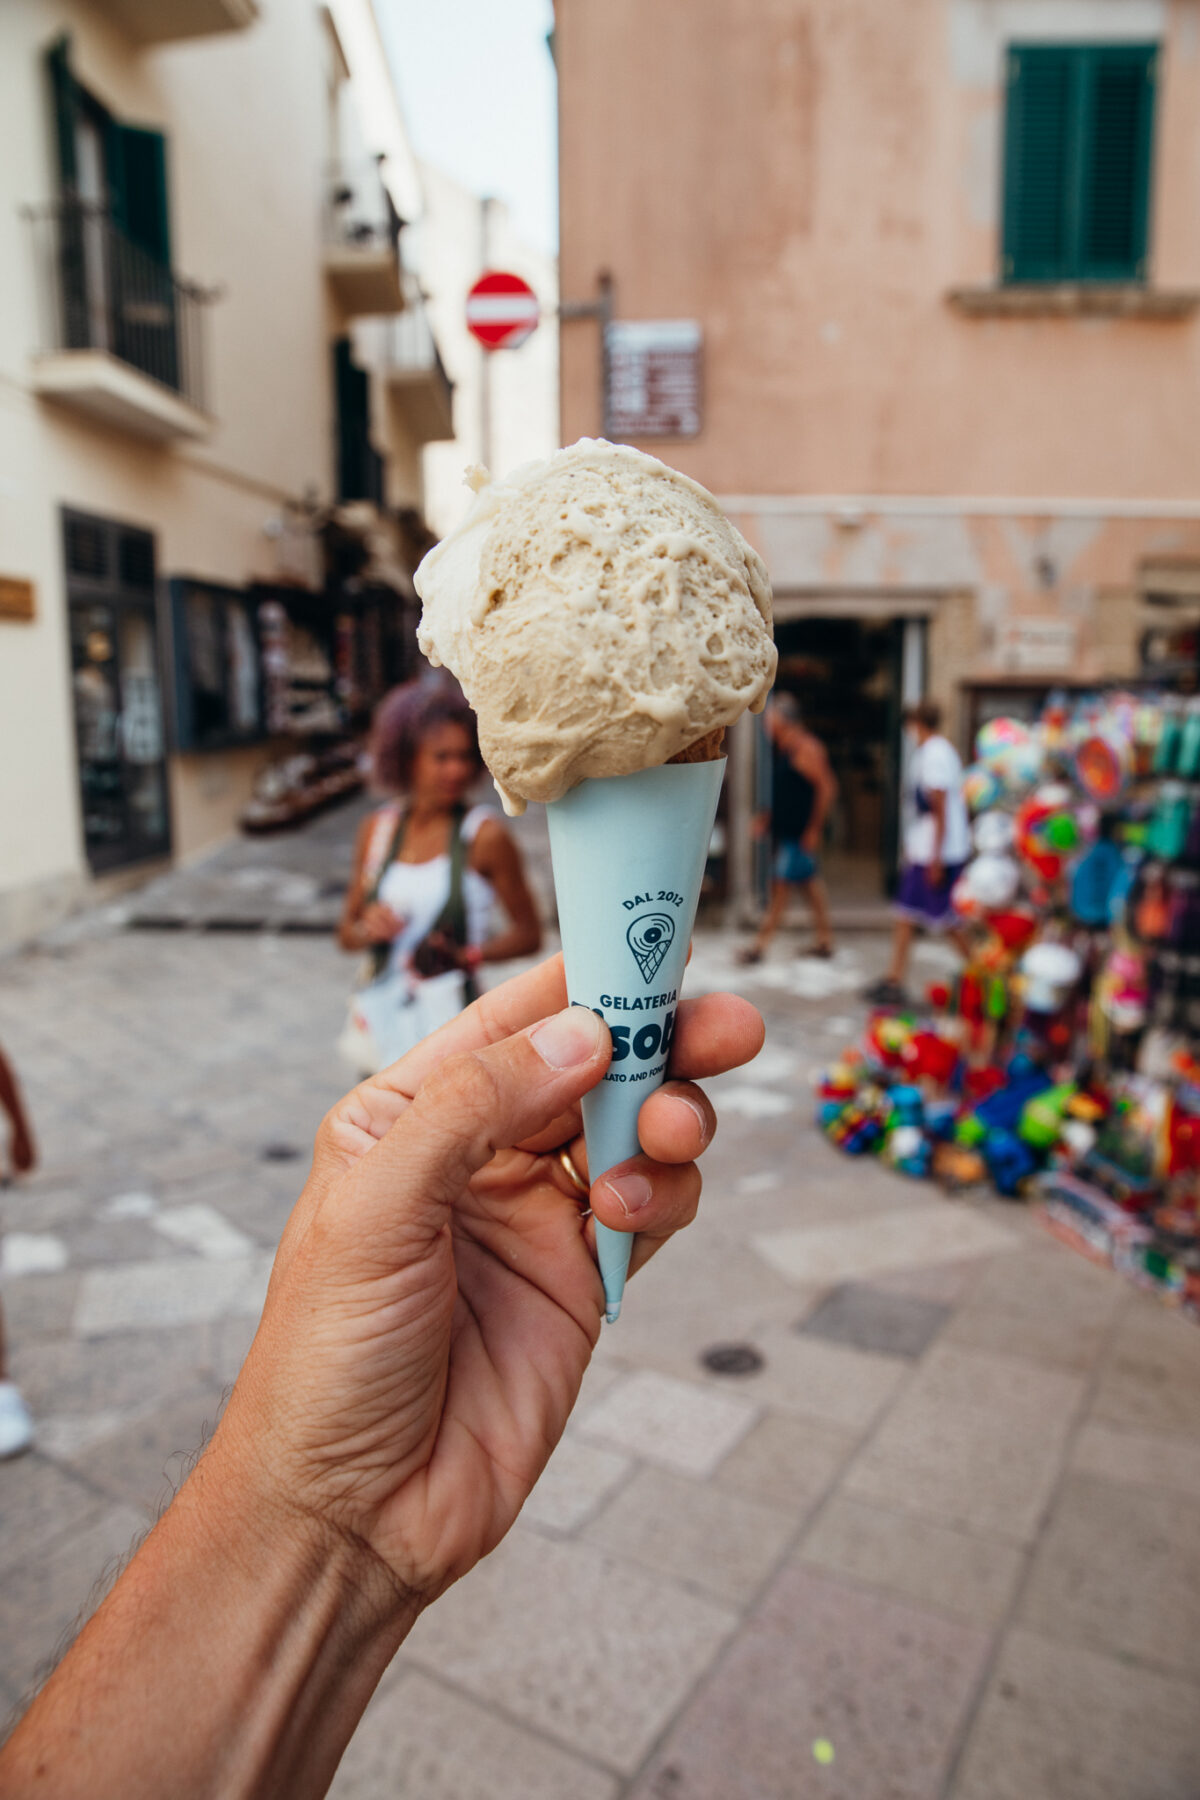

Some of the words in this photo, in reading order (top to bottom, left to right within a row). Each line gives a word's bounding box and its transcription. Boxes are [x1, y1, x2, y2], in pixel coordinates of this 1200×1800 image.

[622, 892, 653, 911] DAL
[656, 890, 684, 908] 2012
[600, 989, 677, 1011] GELATERIA
[603, 1072, 627, 1082] LATO
[629, 1071, 648, 1082] AND
